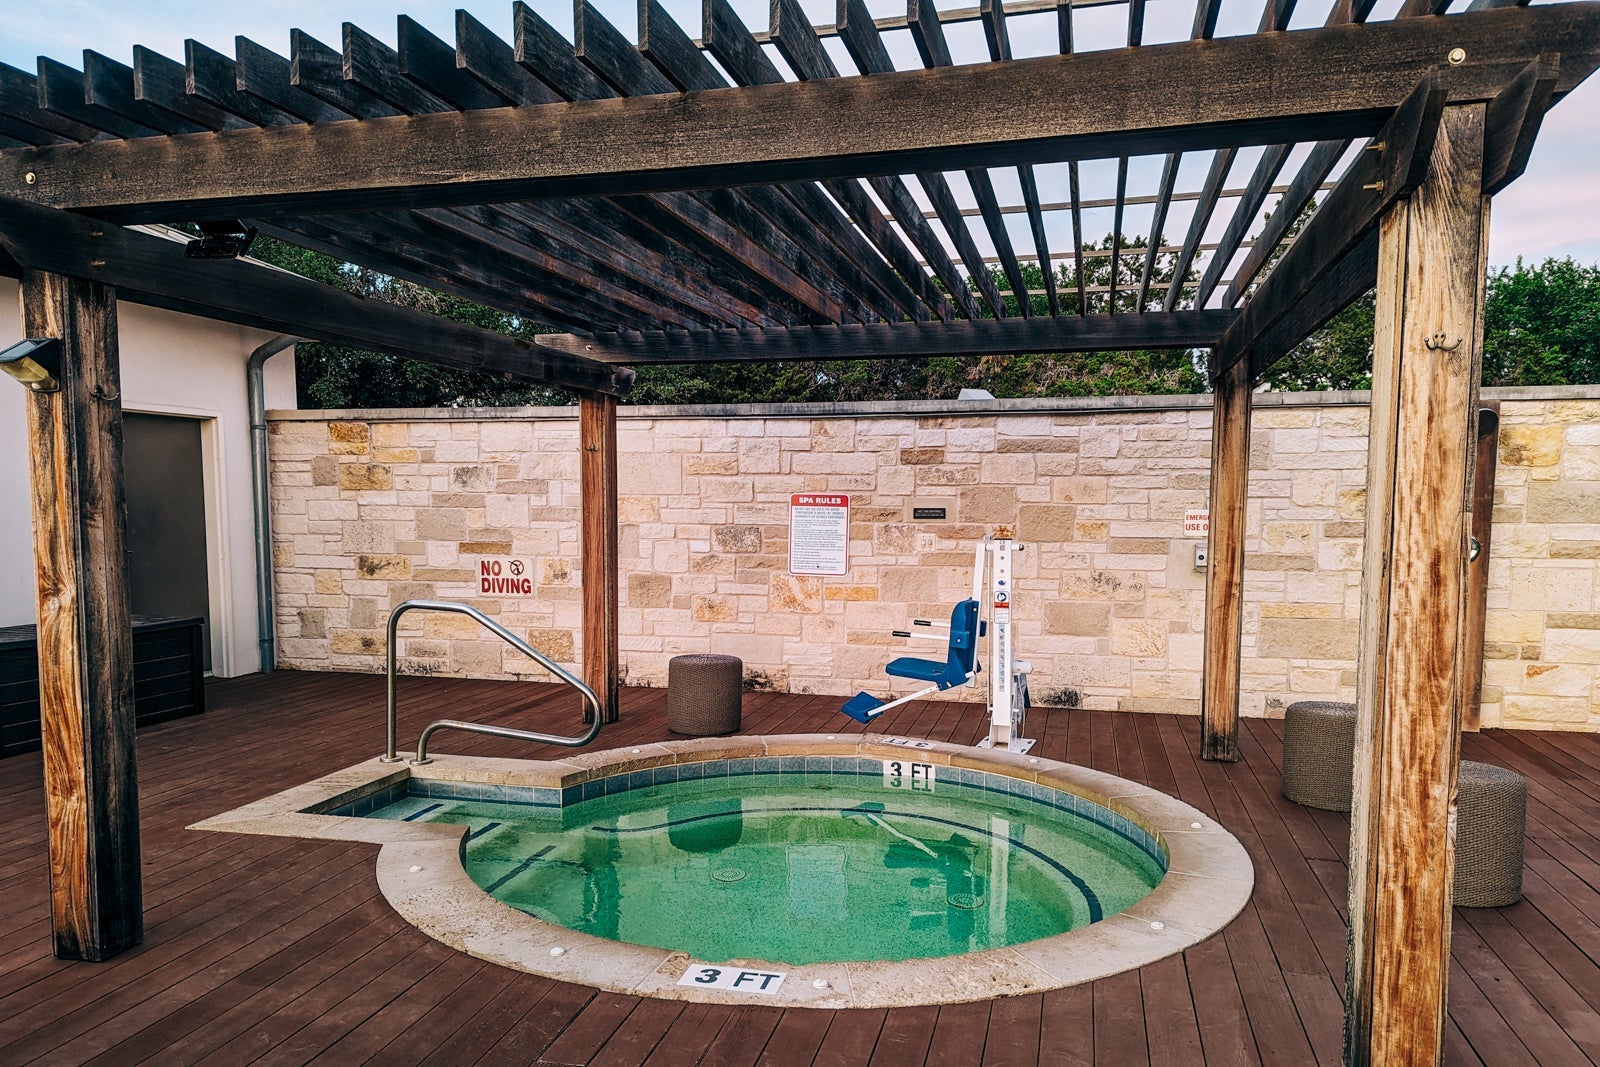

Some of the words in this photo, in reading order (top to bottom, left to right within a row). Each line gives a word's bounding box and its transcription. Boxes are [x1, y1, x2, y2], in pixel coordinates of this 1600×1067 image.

[1185, 523, 1201, 531] USE
[480, 560, 502, 577] NO
[481, 577, 532, 594] DIVING
[890, 761, 902, 777] 3
[911, 762, 933, 780] FT
[694, 968, 722, 984] 3
[732, 971, 781, 990] FT
